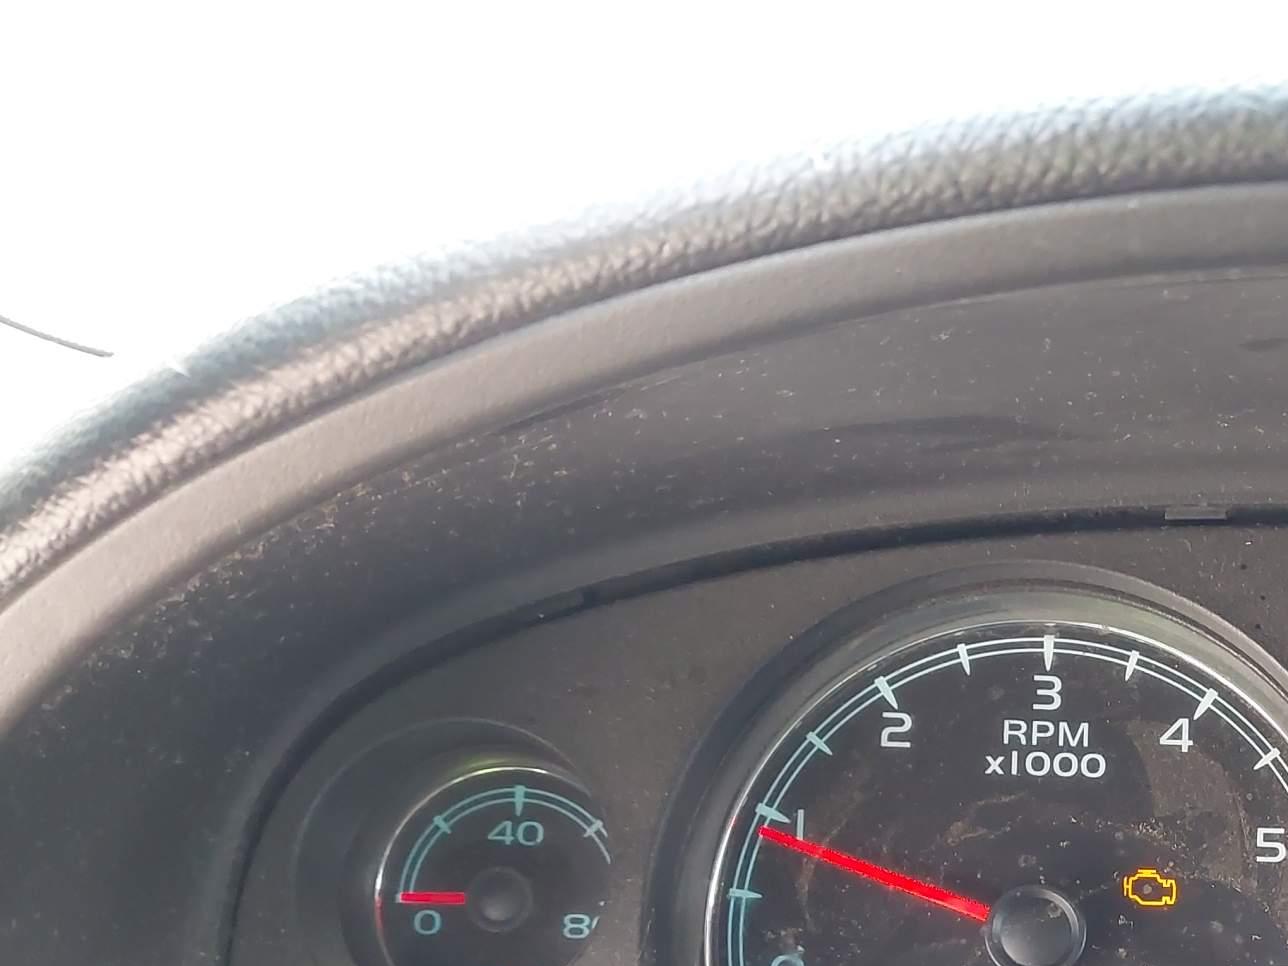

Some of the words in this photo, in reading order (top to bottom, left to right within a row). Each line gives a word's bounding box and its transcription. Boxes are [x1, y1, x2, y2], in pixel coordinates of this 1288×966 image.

[1033, 675, 1062, 710] 3
[880, 712, 912, 748] 2
[1002, 720, 1089, 747] RPM
[1159, 718, 1193, 752] 4
[985, 753, 1106, 778] x1000
[487, 820, 545, 846] 40
[1255, 828, 1288, 863] 5
[413, 909, 442, 935] 0
